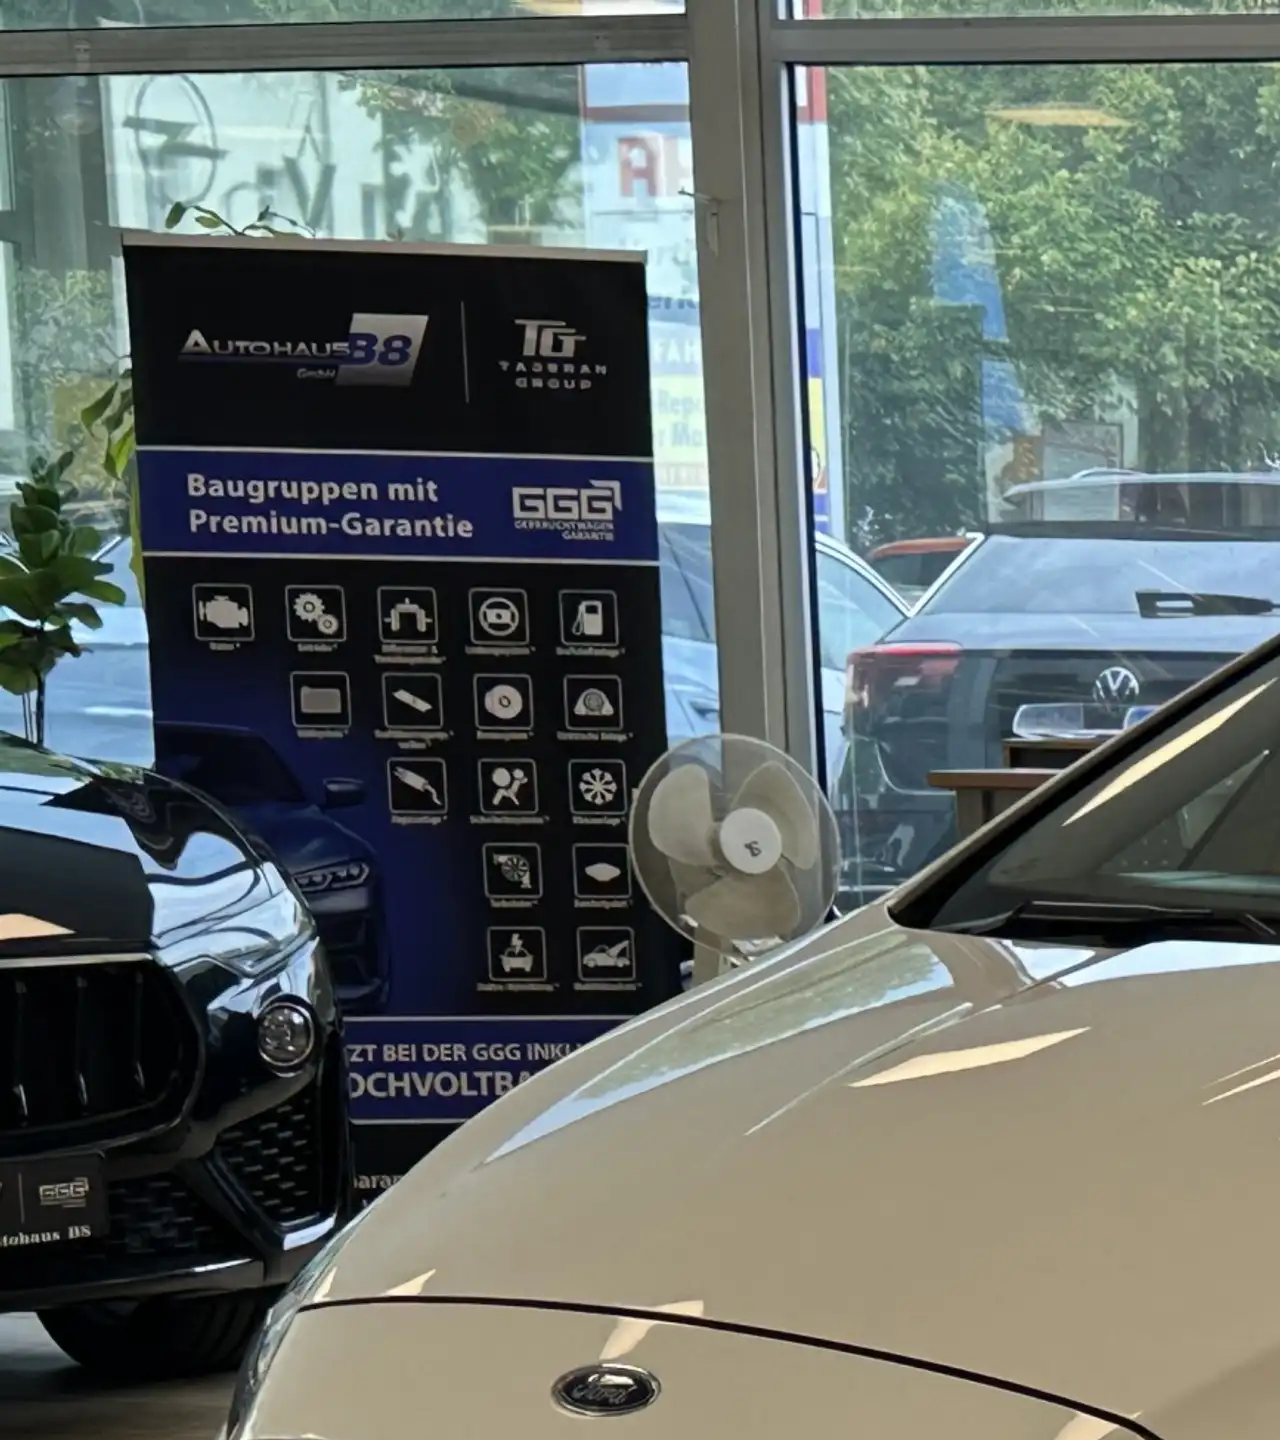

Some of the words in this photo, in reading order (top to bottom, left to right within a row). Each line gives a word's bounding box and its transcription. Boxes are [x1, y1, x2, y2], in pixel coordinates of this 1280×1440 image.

[186, 473, 378, 506] Baugruppen
[388, 478, 438, 502] mit
[512, 486, 614, 520] GGG
[189, 509, 474, 538] Premium-Garantie
[383, 1043, 417, 1062] BEI
[423, 1043, 467, 1062] DER
[472, 1042, 521, 1061] GGG
